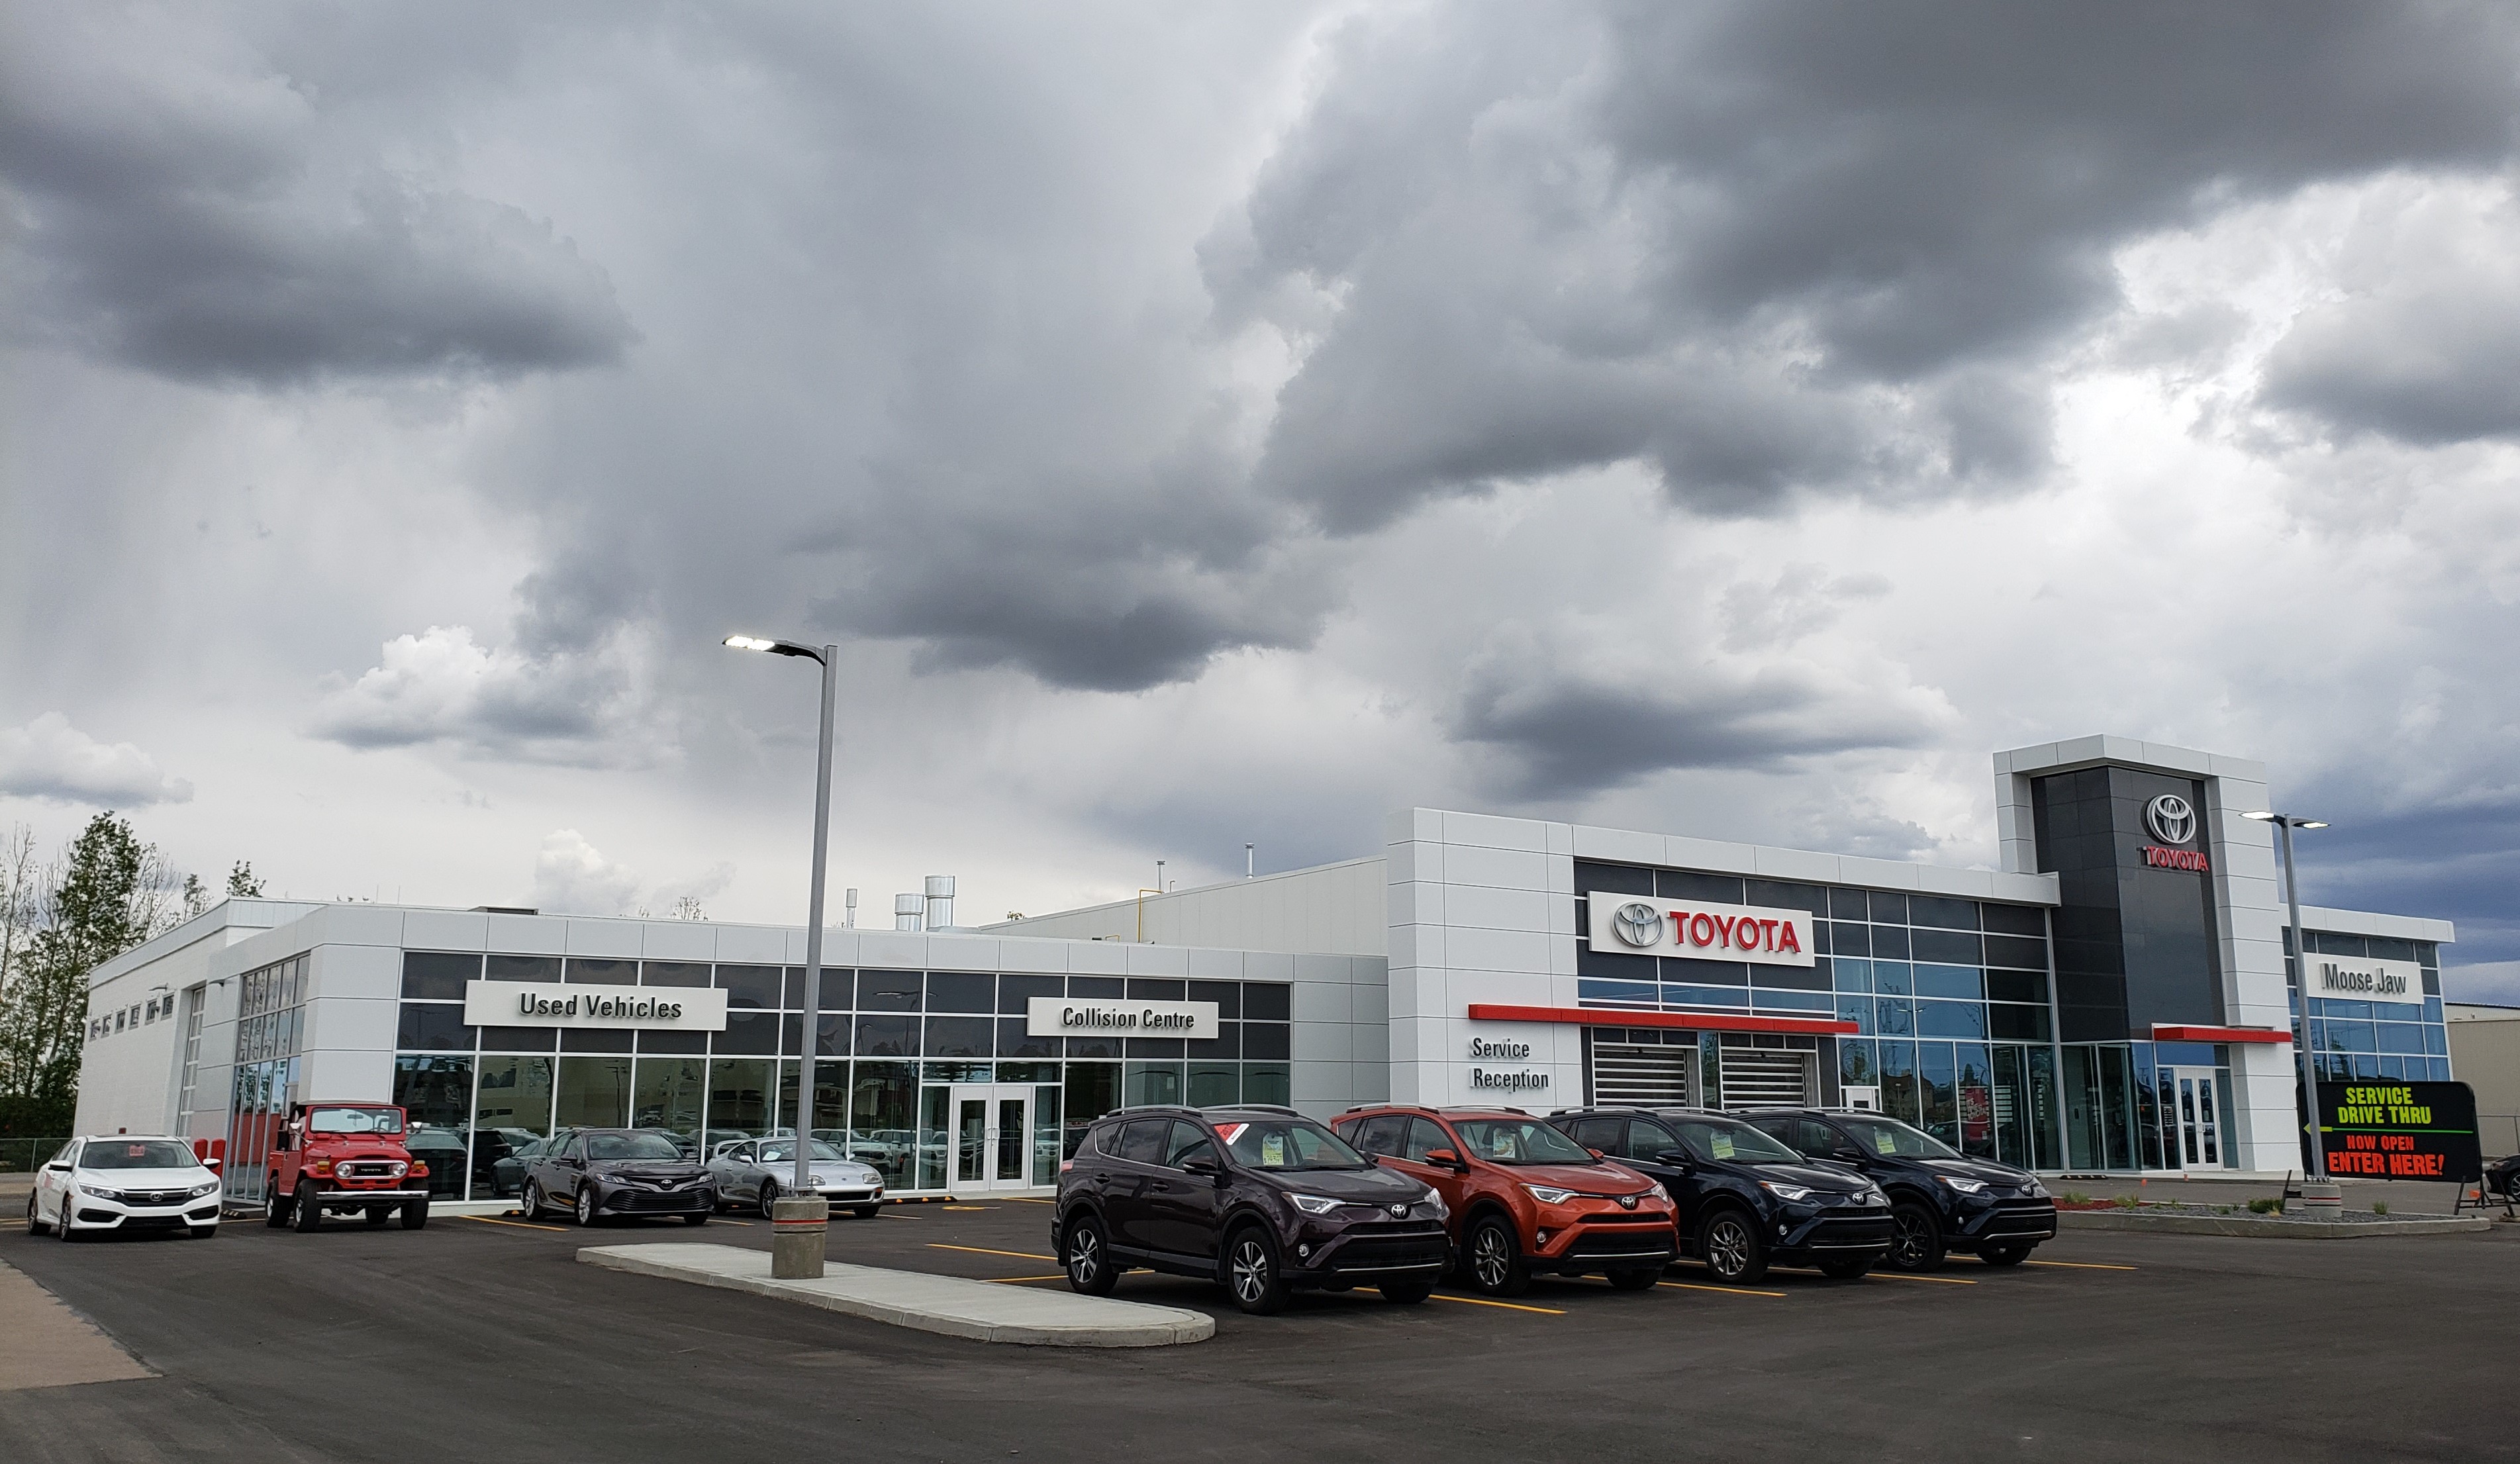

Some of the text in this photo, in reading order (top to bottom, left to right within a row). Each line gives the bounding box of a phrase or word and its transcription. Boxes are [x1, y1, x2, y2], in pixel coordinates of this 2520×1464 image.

[2147, 846, 2209, 871] TOYOTA
[1669, 911, 1801, 953] TOYOTA
[2323, 963, 2406, 993] Moose Jaw
[520, 993, 683, 1018] Used Vehicles
[1063, 1007, 1195, 1028] Collision Centre
[1473, 1037, 1530, 1057] Service
[1473, 1067, 1549, 1093] Reception
[2346, 1087, 2413, 1105] SERVICE
[2337, 1106, 2432, 1124] DRIVE THRU
[2346, 1135, 2414, 1151] NOW OPEN
[2327, 1151, 2445, 1176] ENTER HERE!
